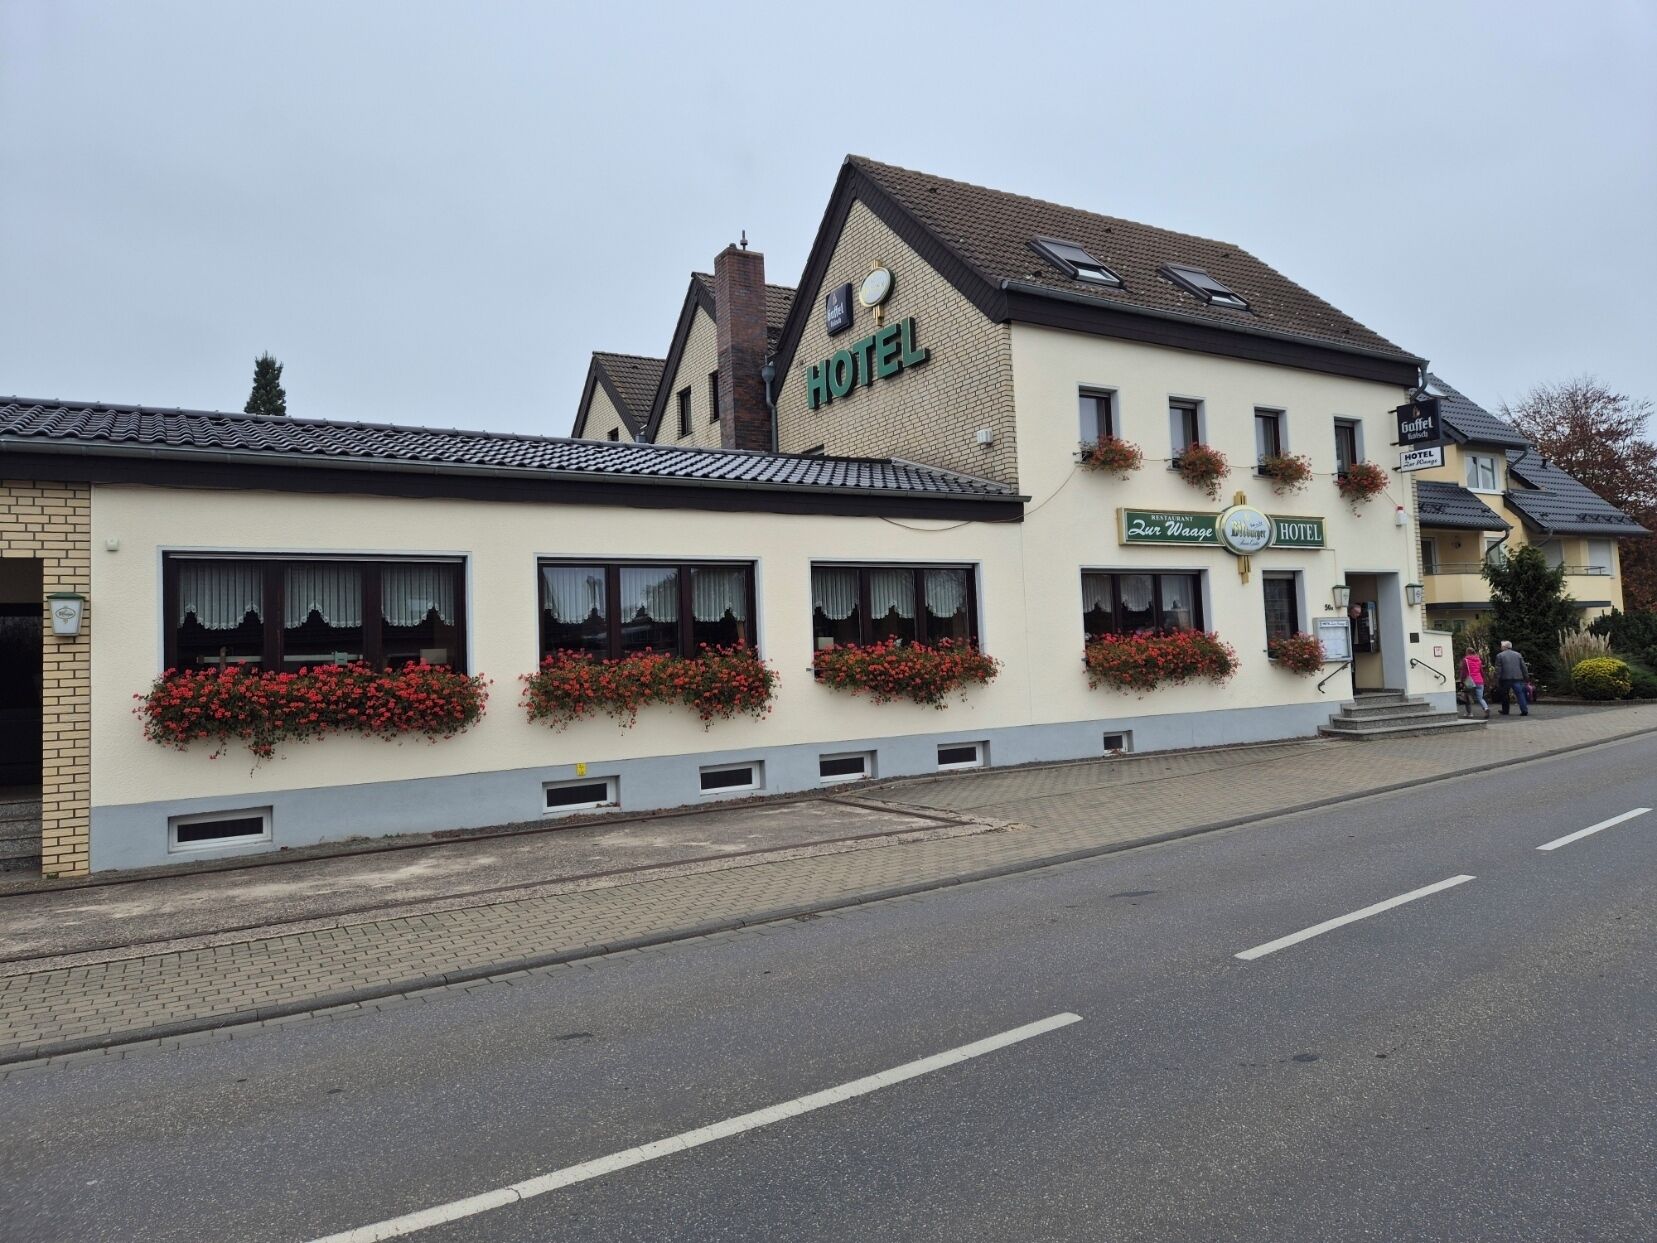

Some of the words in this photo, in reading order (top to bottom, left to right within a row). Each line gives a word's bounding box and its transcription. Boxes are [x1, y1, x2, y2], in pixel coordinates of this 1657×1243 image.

[806, 316, 927, 410] HOTEL
[1401, 415, 1434, 434] Gaffel
[1404, 451, 1434, 460] HOTEL
[1151, 514, 1194, 522] RESTAURANT
[1128, 519, 1161, 536] Zur
[1165, 520, 1213, 542] Waage
[1279, 522, 1322, 541] HOTEL
